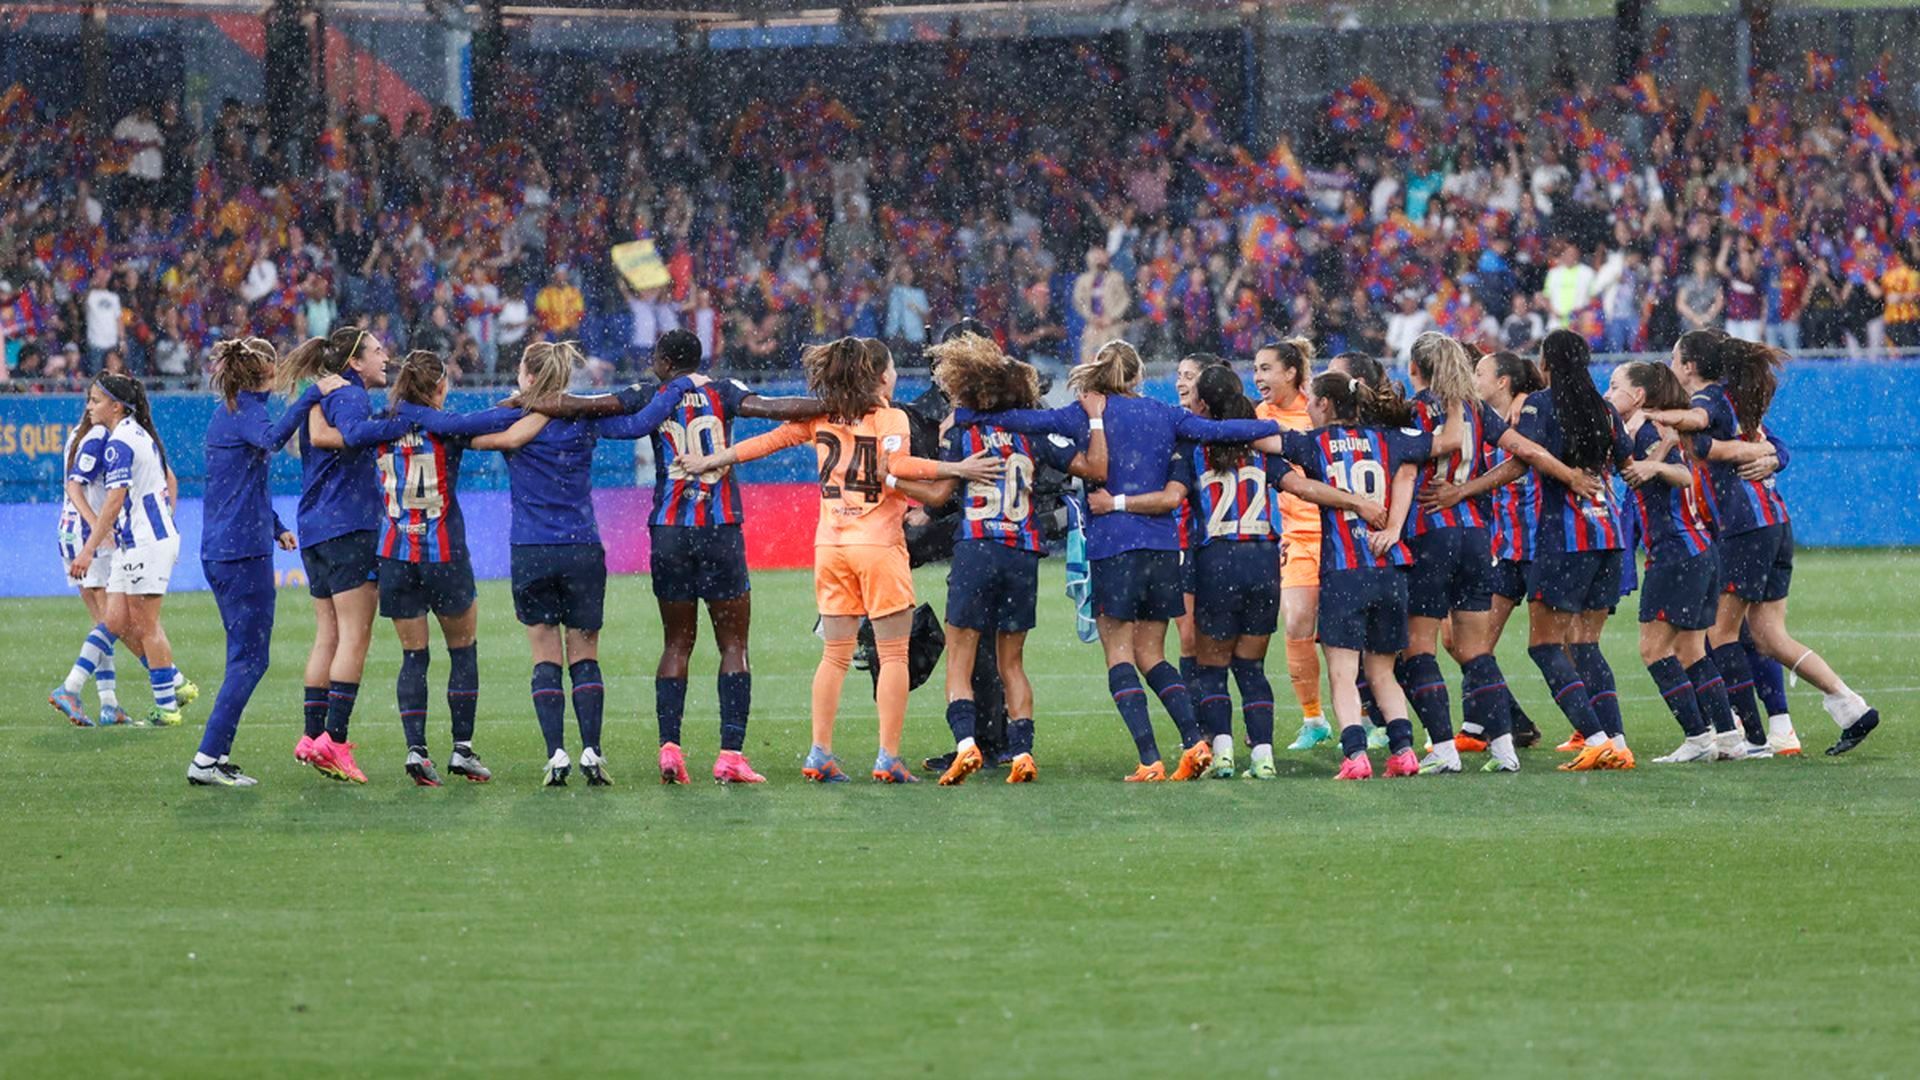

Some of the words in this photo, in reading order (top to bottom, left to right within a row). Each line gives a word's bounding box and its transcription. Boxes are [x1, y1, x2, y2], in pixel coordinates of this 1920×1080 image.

[20, 423, 63, 460] QUE
[815, 430, 882, 503] 24
[376, 452, 444, 519] 14
[1199, 465, 1271, 538] 22
